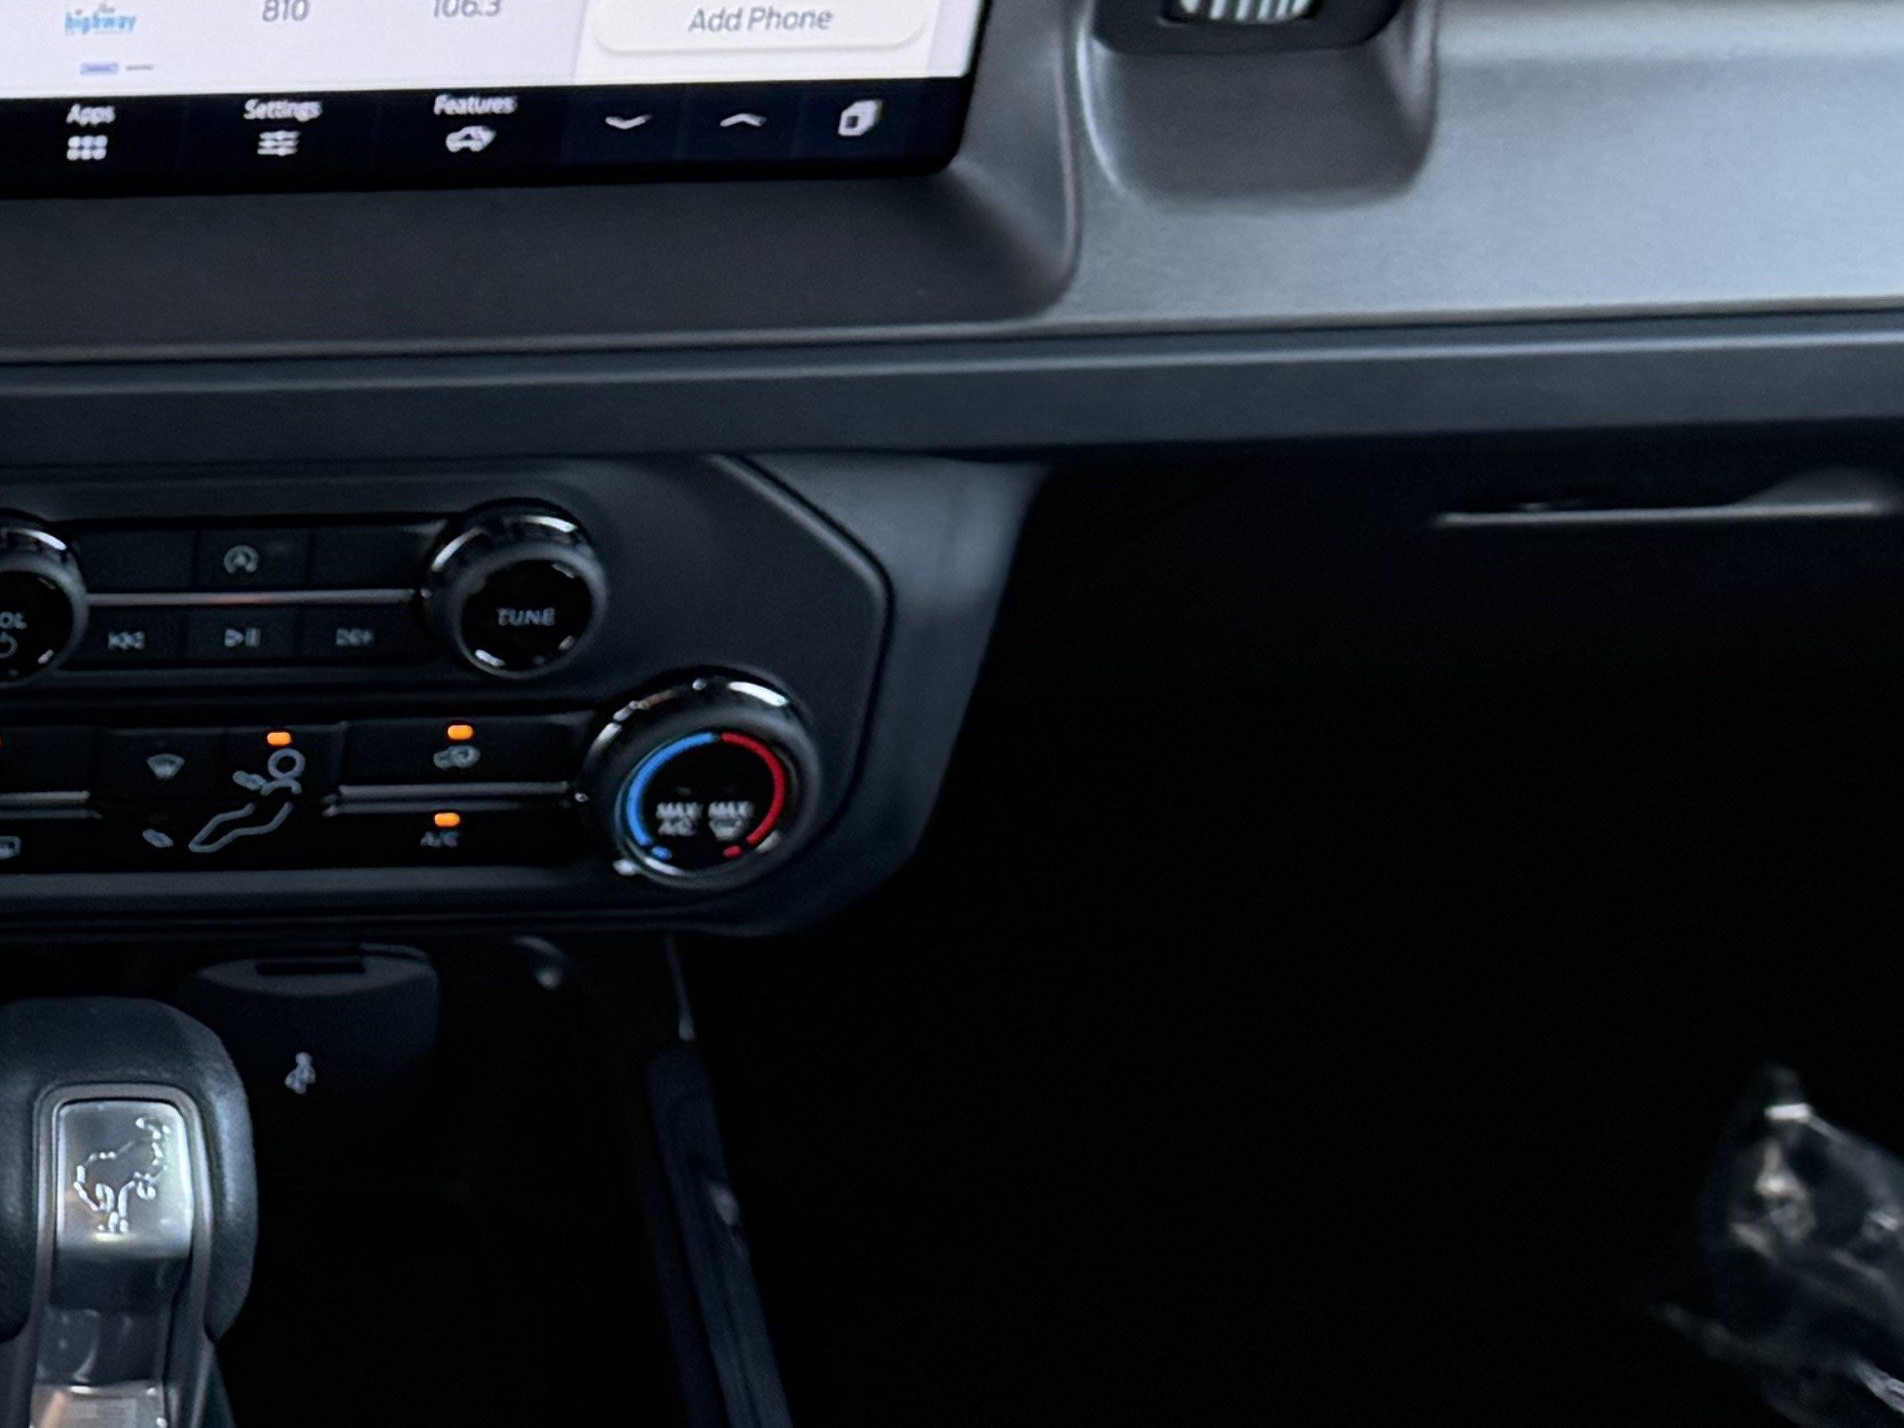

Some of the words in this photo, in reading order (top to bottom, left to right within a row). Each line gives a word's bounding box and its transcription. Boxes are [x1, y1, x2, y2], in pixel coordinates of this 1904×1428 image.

[687, 5, 744, 32] Add
[746, 4, 834, 33] Phone
[65, 102, 117, 127] Apps
[242, 98, 324, 123] Settings
[432, 94, 518, 117] Features
[495, 607, 556, 628] TUNE
